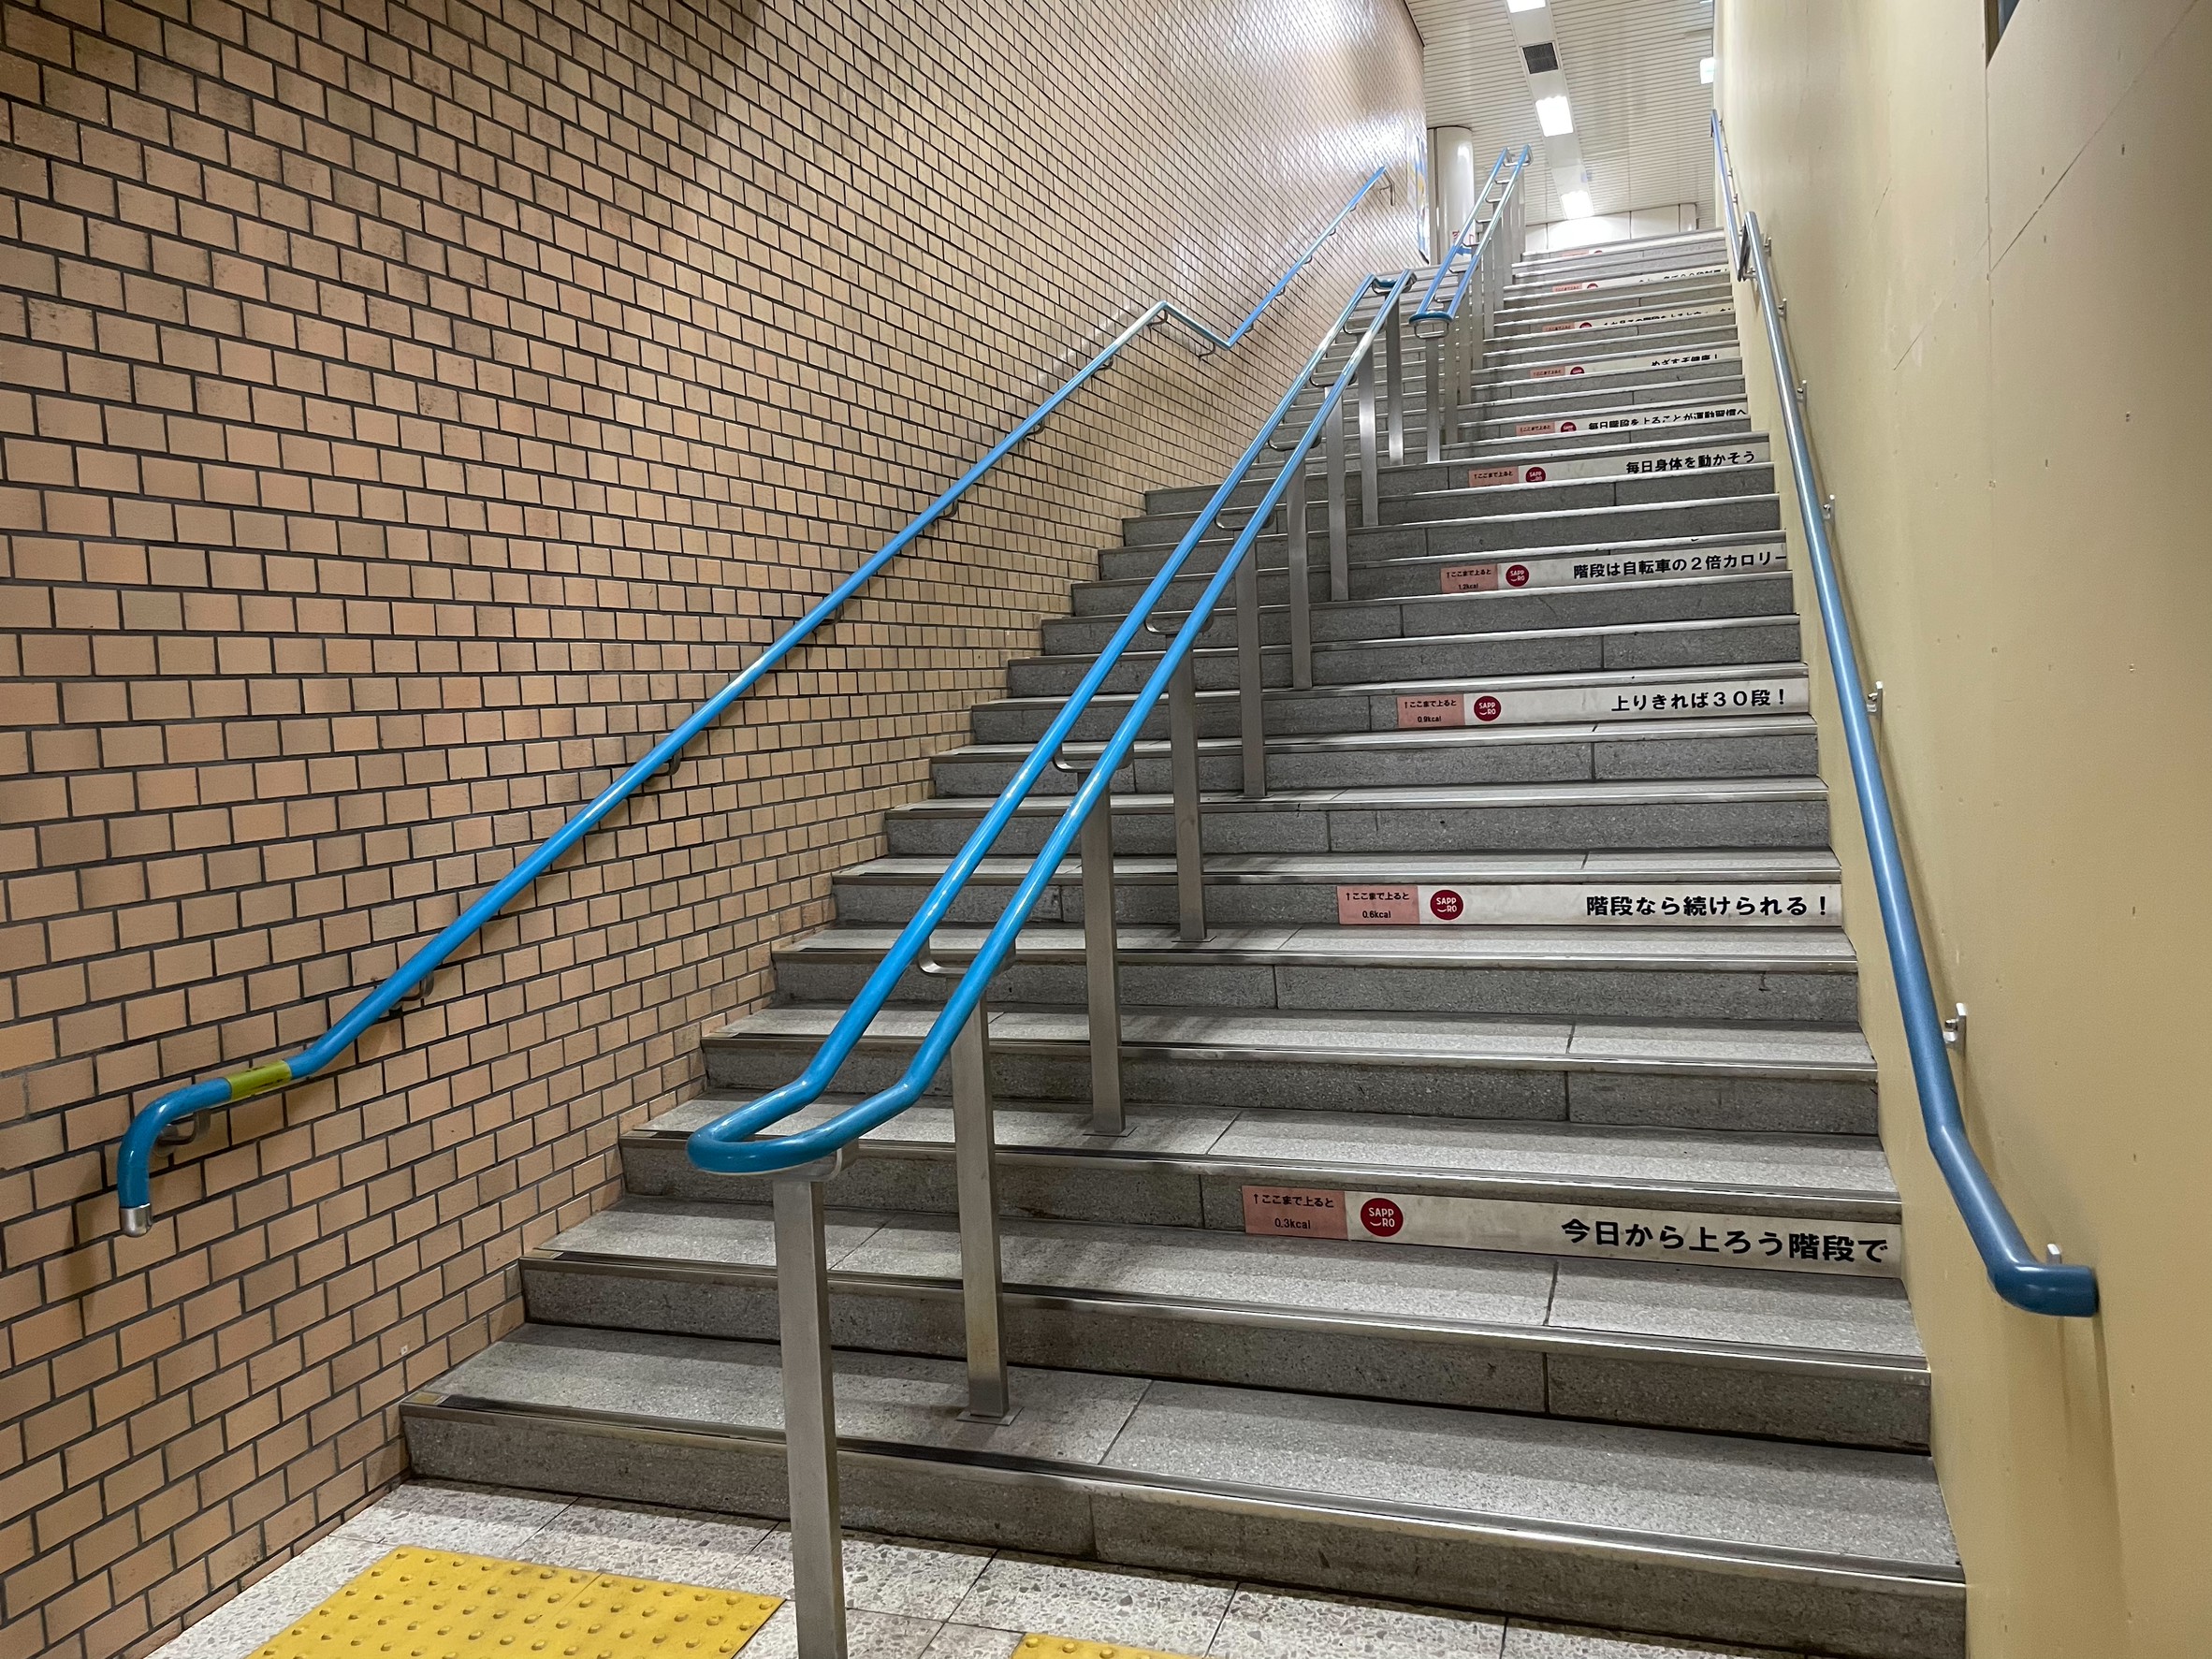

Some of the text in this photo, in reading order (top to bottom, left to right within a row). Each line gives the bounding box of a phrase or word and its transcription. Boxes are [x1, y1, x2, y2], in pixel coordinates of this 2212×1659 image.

[1626, 451, 1755, 474] 毎日身体を動かそう
[1353, 892, 1410, 901] ここまで上ると
[1361, 910, 1391, 919] 0.6kcal
[1262, 1194, 1334, 1208] ここまで上ると
[1274, 1218, 1311, 1230] 0.3kcal
[1561, 1218, 1888, 1263] 今日から上ろう階段で
